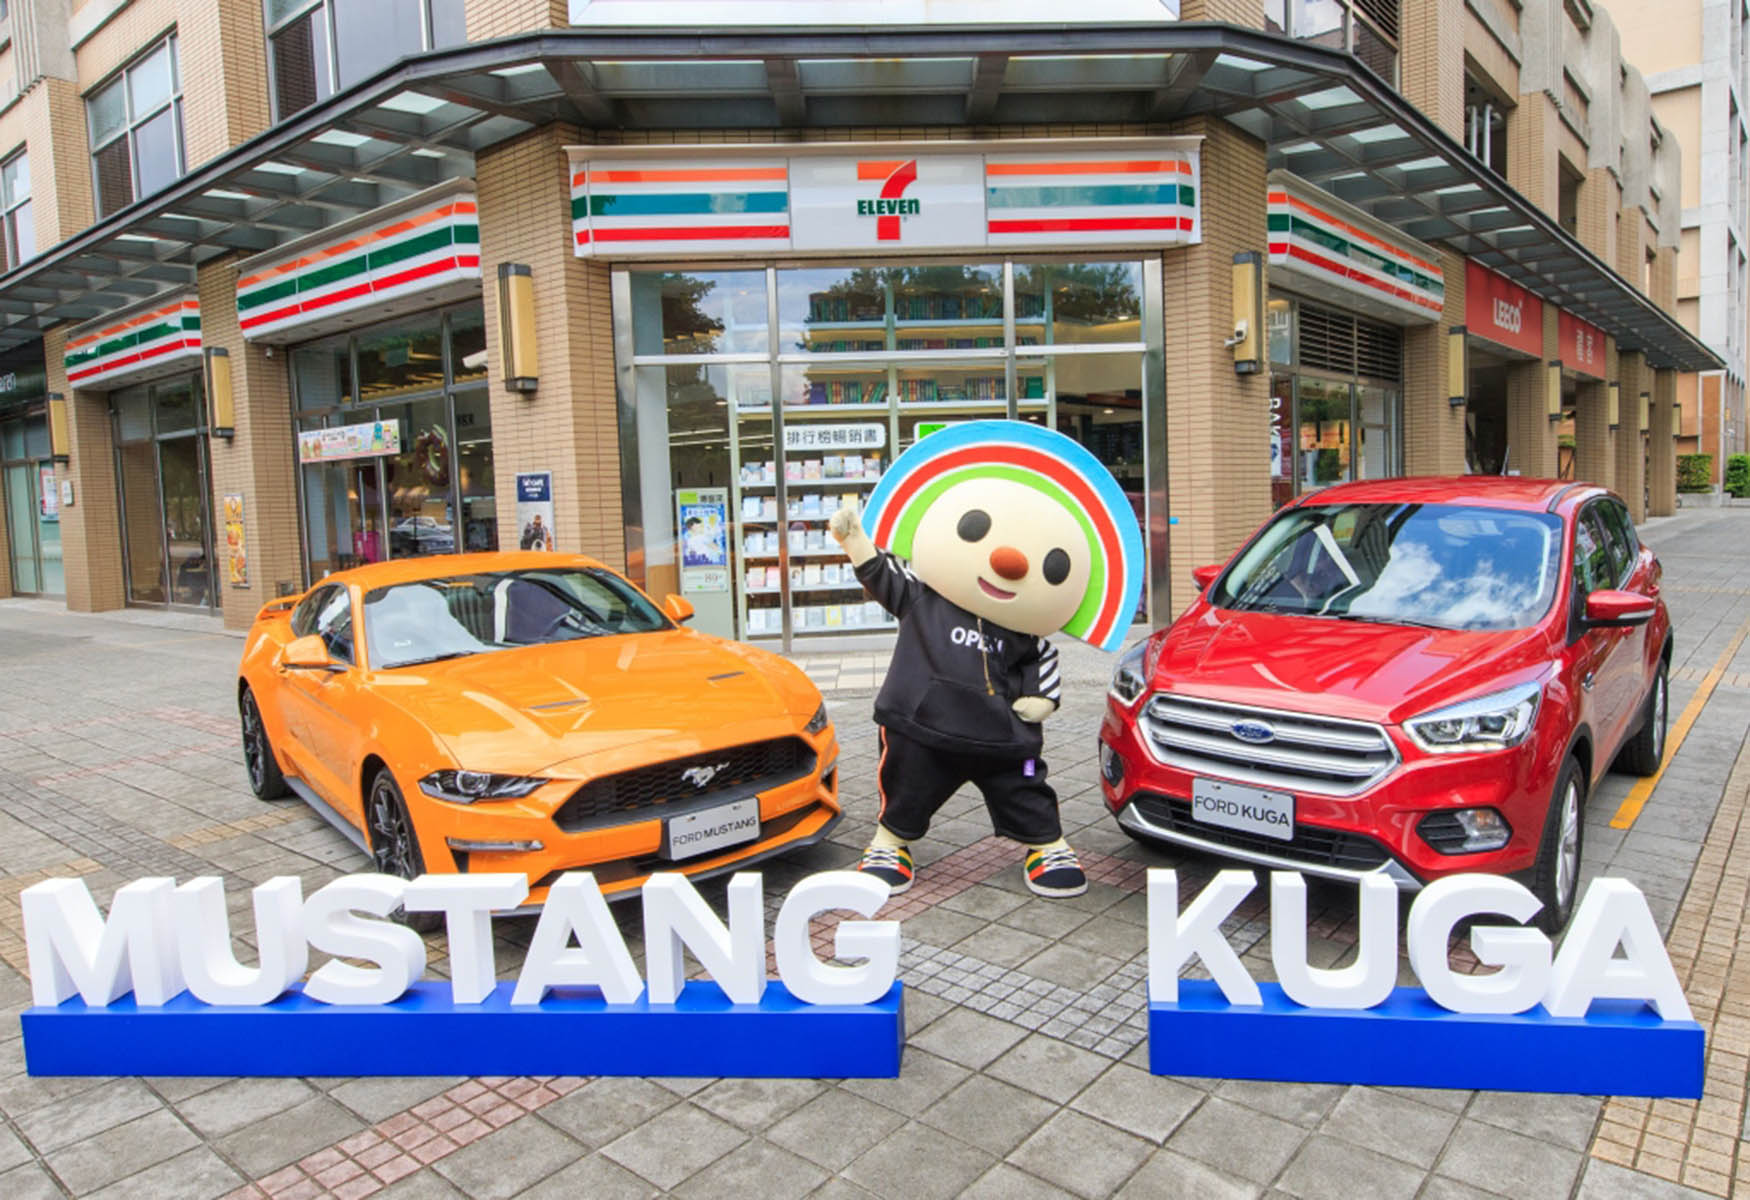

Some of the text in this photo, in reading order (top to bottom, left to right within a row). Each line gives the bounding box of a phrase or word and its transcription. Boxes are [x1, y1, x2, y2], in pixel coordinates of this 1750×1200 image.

[857, 160, 917, 241] 7
[672, 816, 757, 847] FORD MUSTANG
[1195, 796, 1290, 827] FORD KUGA
[20, 870, 901, 1006] MUSTANG
[1146, 868, 1694, 1022] KUGA
